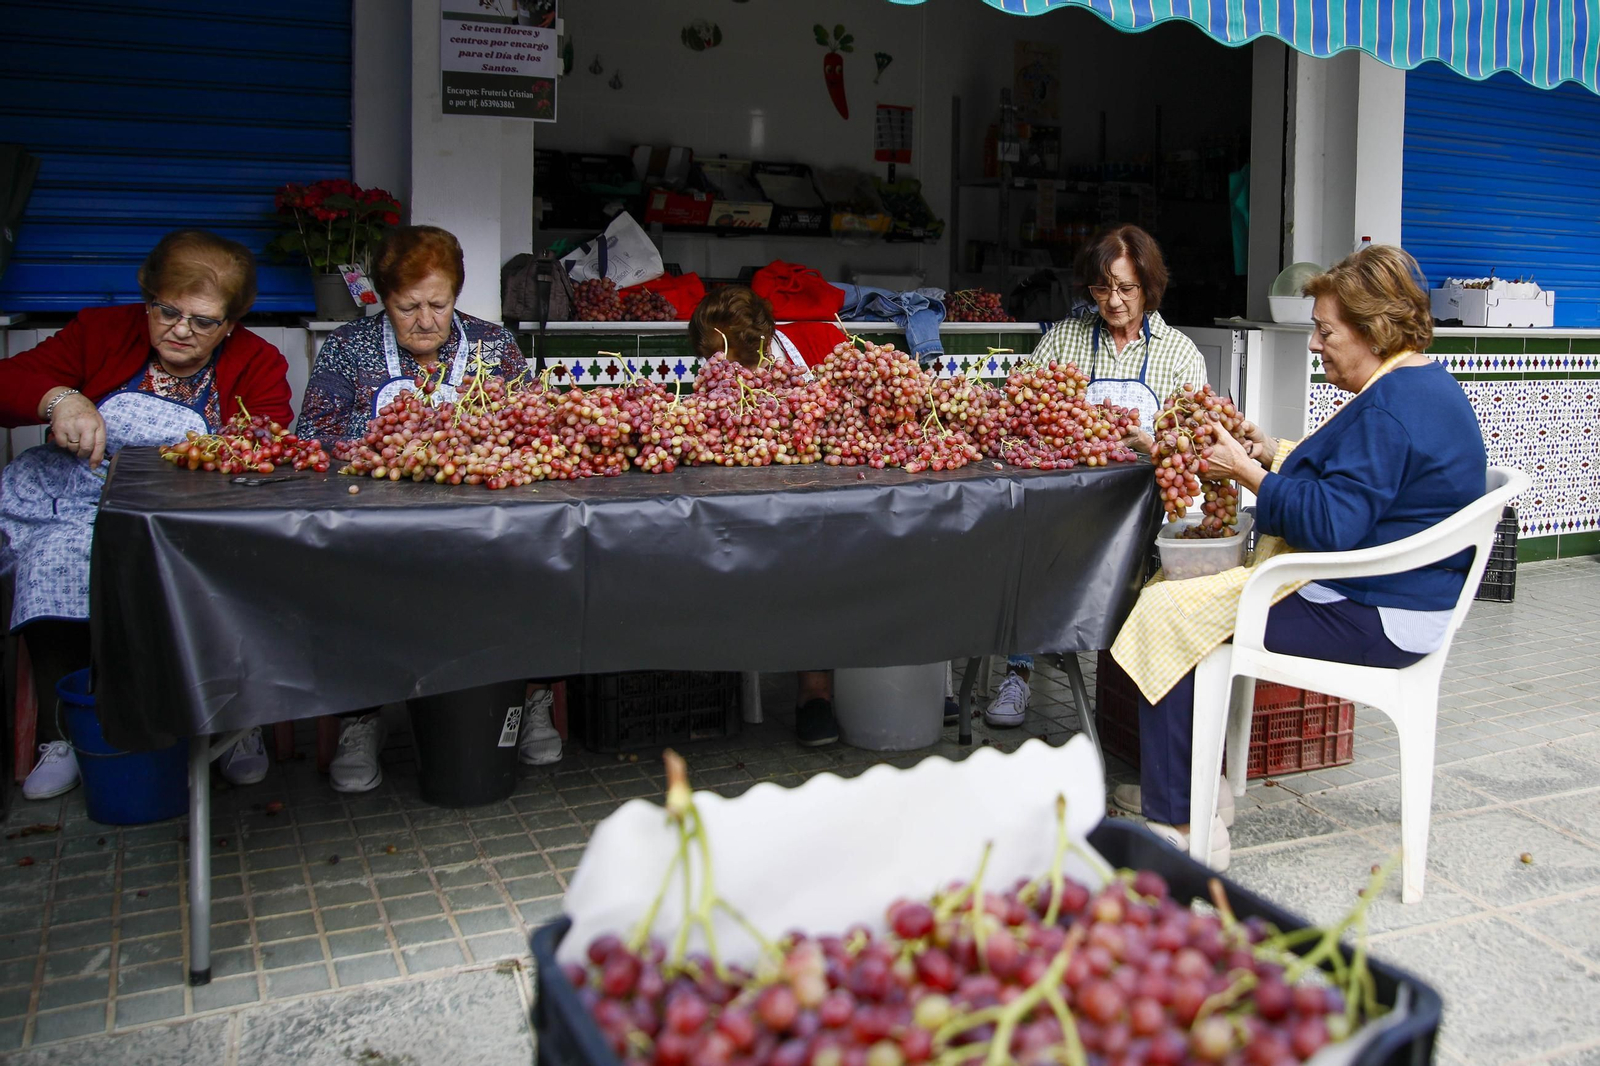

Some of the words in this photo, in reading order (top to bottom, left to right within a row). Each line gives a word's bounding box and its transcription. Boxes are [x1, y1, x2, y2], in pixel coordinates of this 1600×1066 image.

[460, 23, 473, 31] Se
[474, 25, 502, 34] traen
[503, 26, 532, 35] flores
[533, 30, 540, 38] y
[450, 36, 489, 45] centros
[490, 40, 509, 48] por
[510, 42, 549, 51] encargo
[458, 50, 483, 58] para
[496, 52, 512, 60] Día
[514, 53, 525, 61] de
[527, 54, 542, 62] los
[481, 64, 519, 73] Santos.
[447, 86, 479, 96] Encargos:
[481, 88, 508, 97] Frutería
[509, 90, 534, 99] Cristian
[480, 100, 515, 109] 653963861
